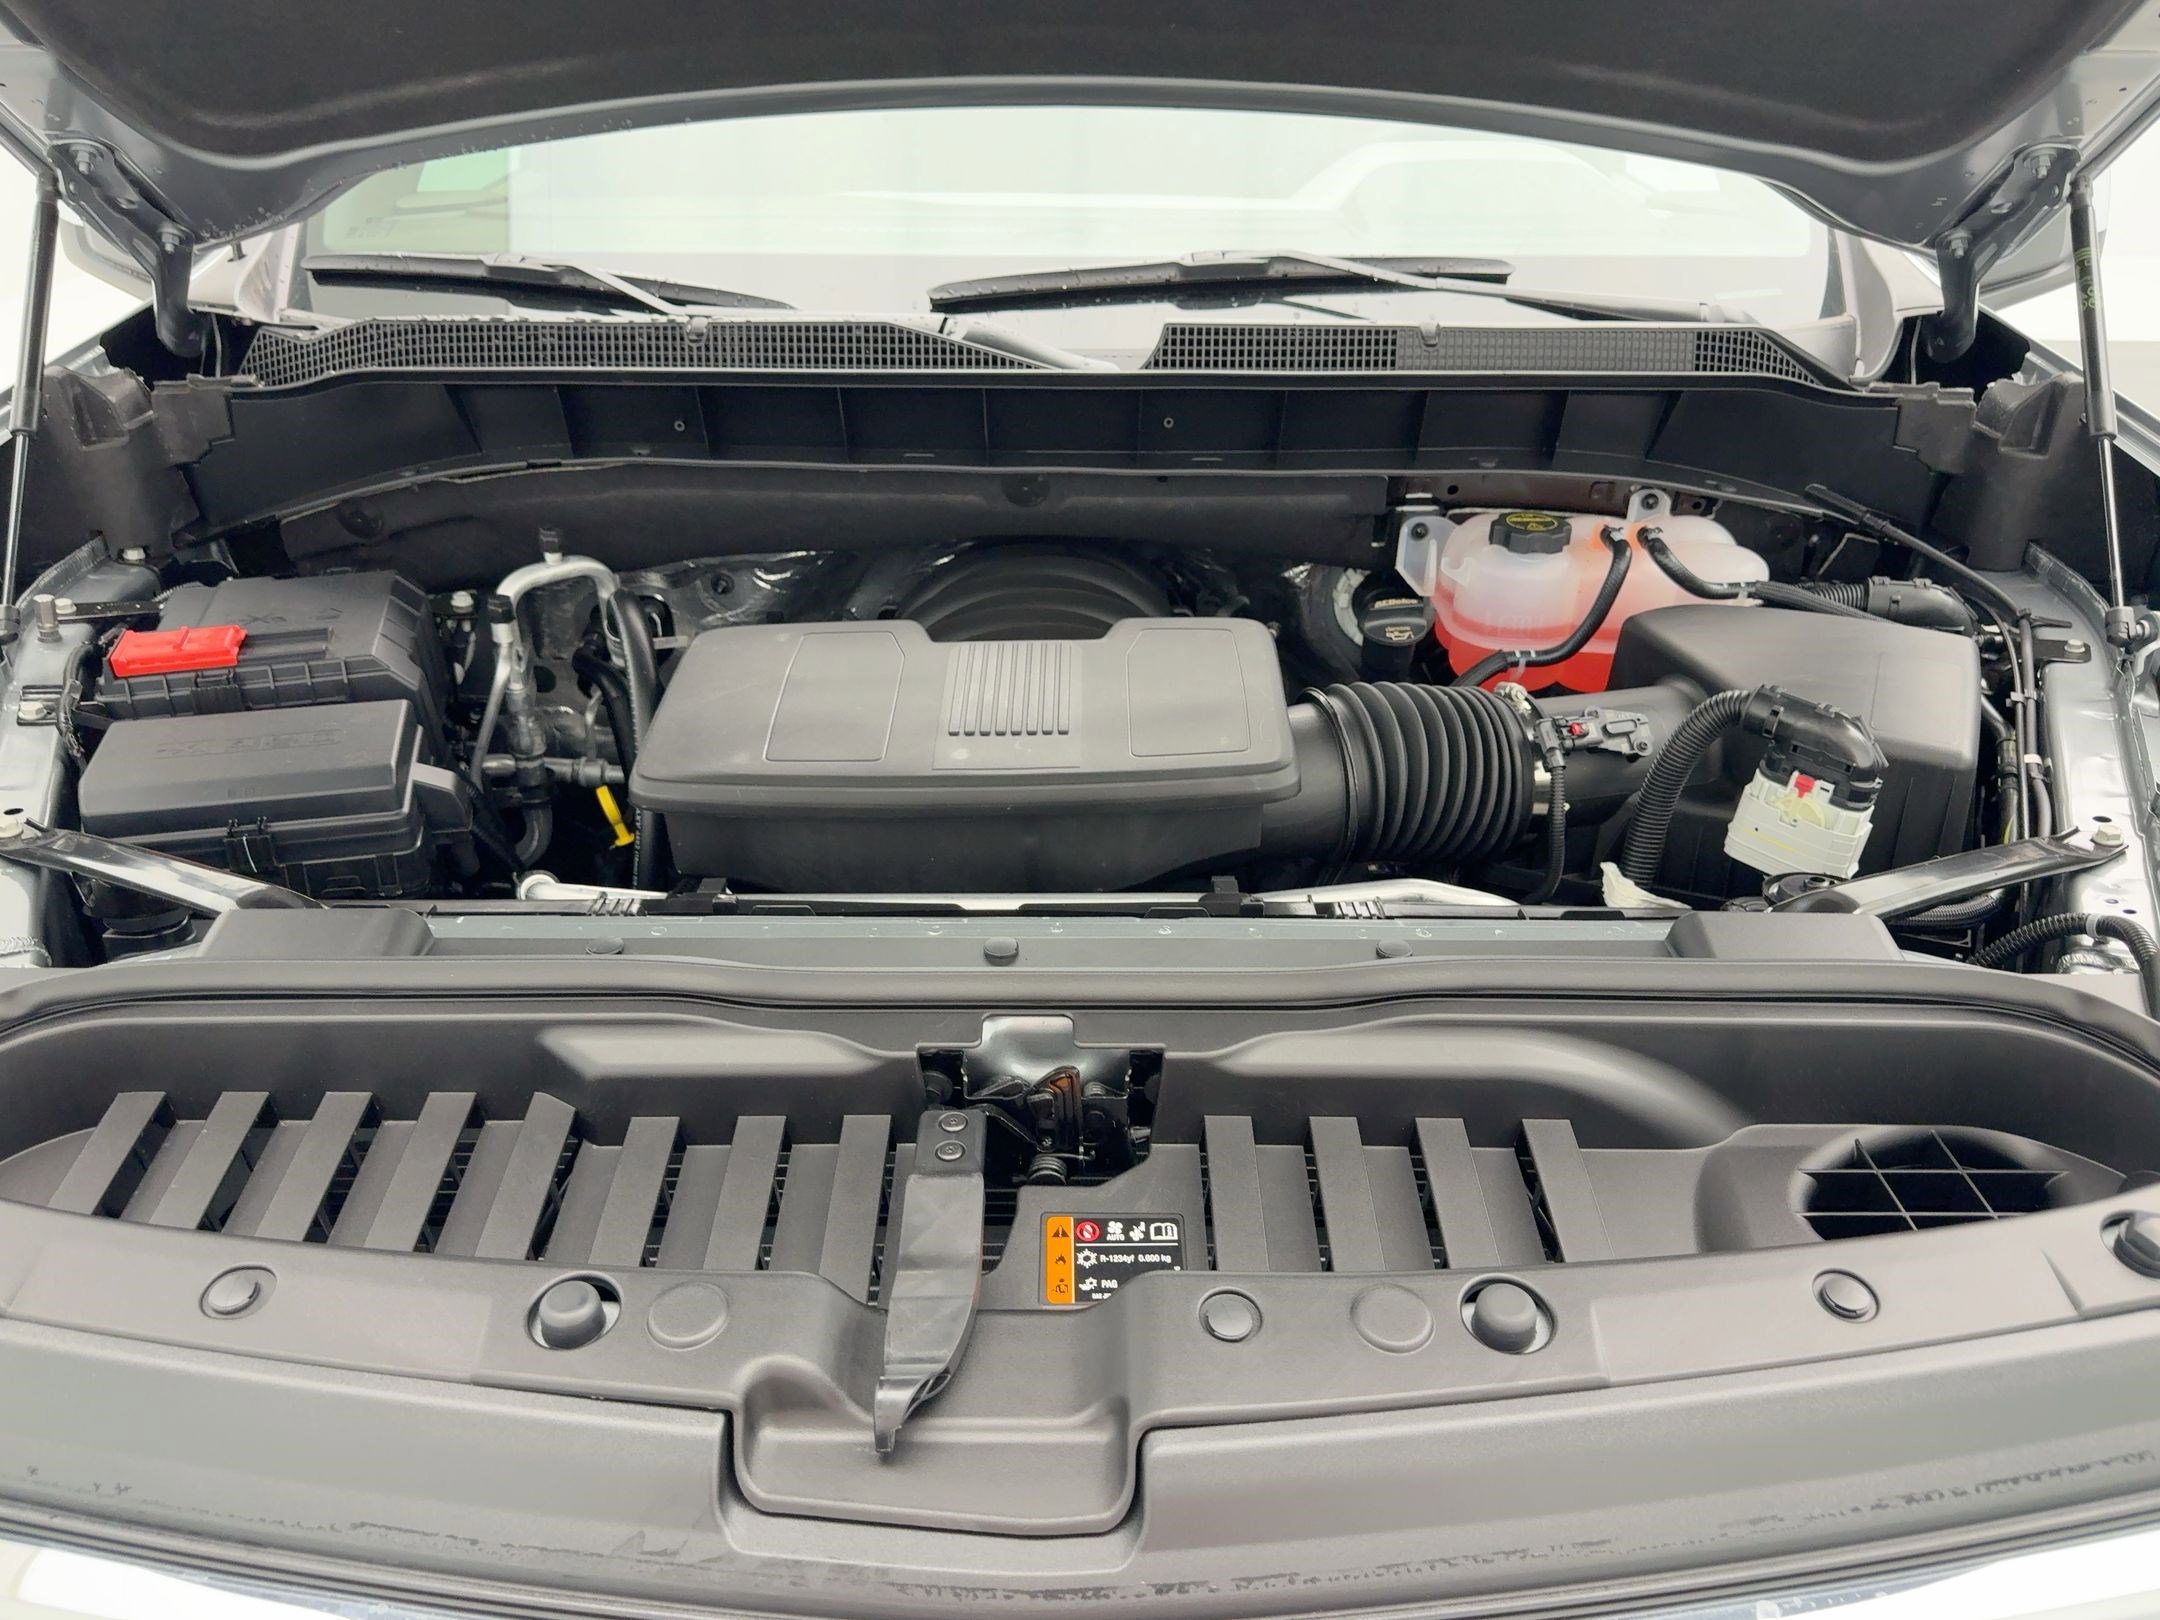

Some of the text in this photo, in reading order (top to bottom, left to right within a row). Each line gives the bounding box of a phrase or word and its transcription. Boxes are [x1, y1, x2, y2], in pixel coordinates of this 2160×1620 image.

[1106, 1233, 1125, 1241] AUTO
[1161, 1254, 1172, 1264] kg
[1101, 1279, 1118, 1289] PAG
